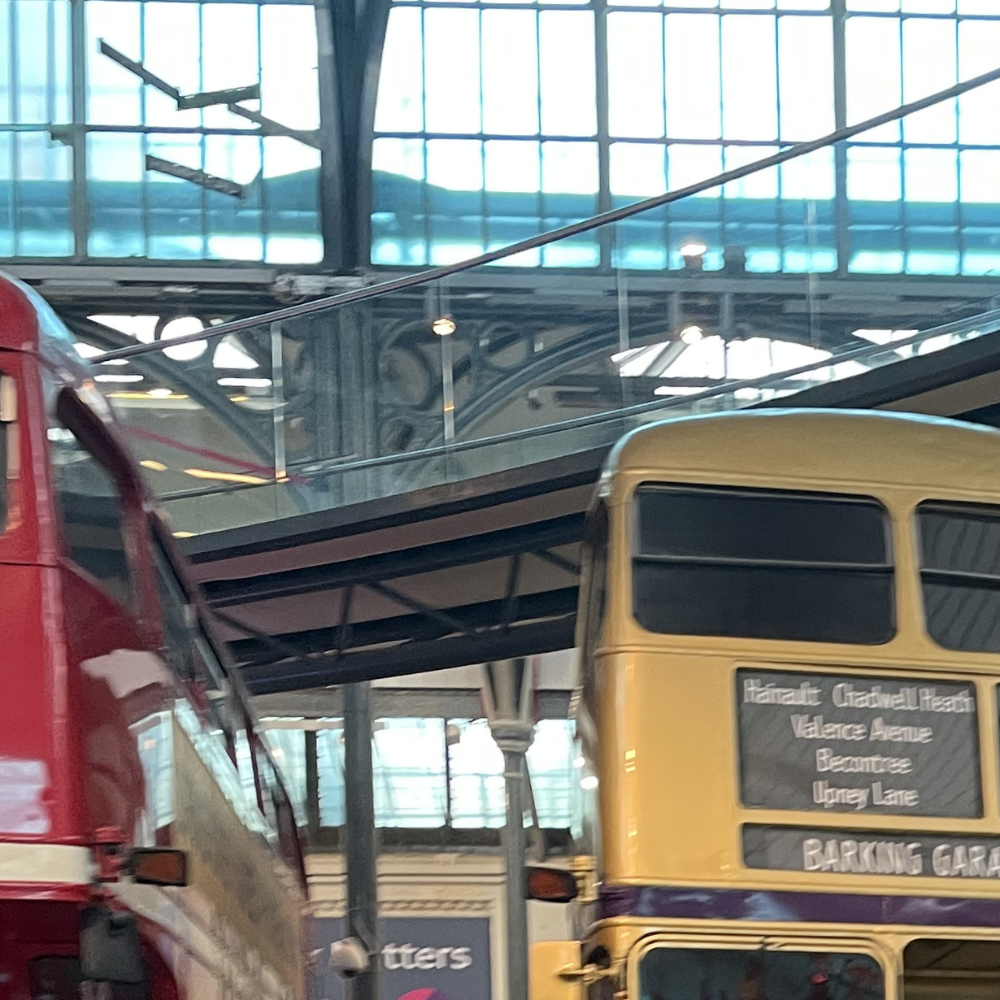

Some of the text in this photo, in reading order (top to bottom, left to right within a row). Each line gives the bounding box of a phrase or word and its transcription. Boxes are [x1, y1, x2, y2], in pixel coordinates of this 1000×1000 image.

[832, 683, 919, 711] Chadwell
[790, 715, 933, 744] Valence Avenue
[816, 747, 913, 774] Becontree
[813, 780, 919, 810] Upney Lane
[803, 838, 923, 875] BARKING
[381, 942, 472, 970] tters
